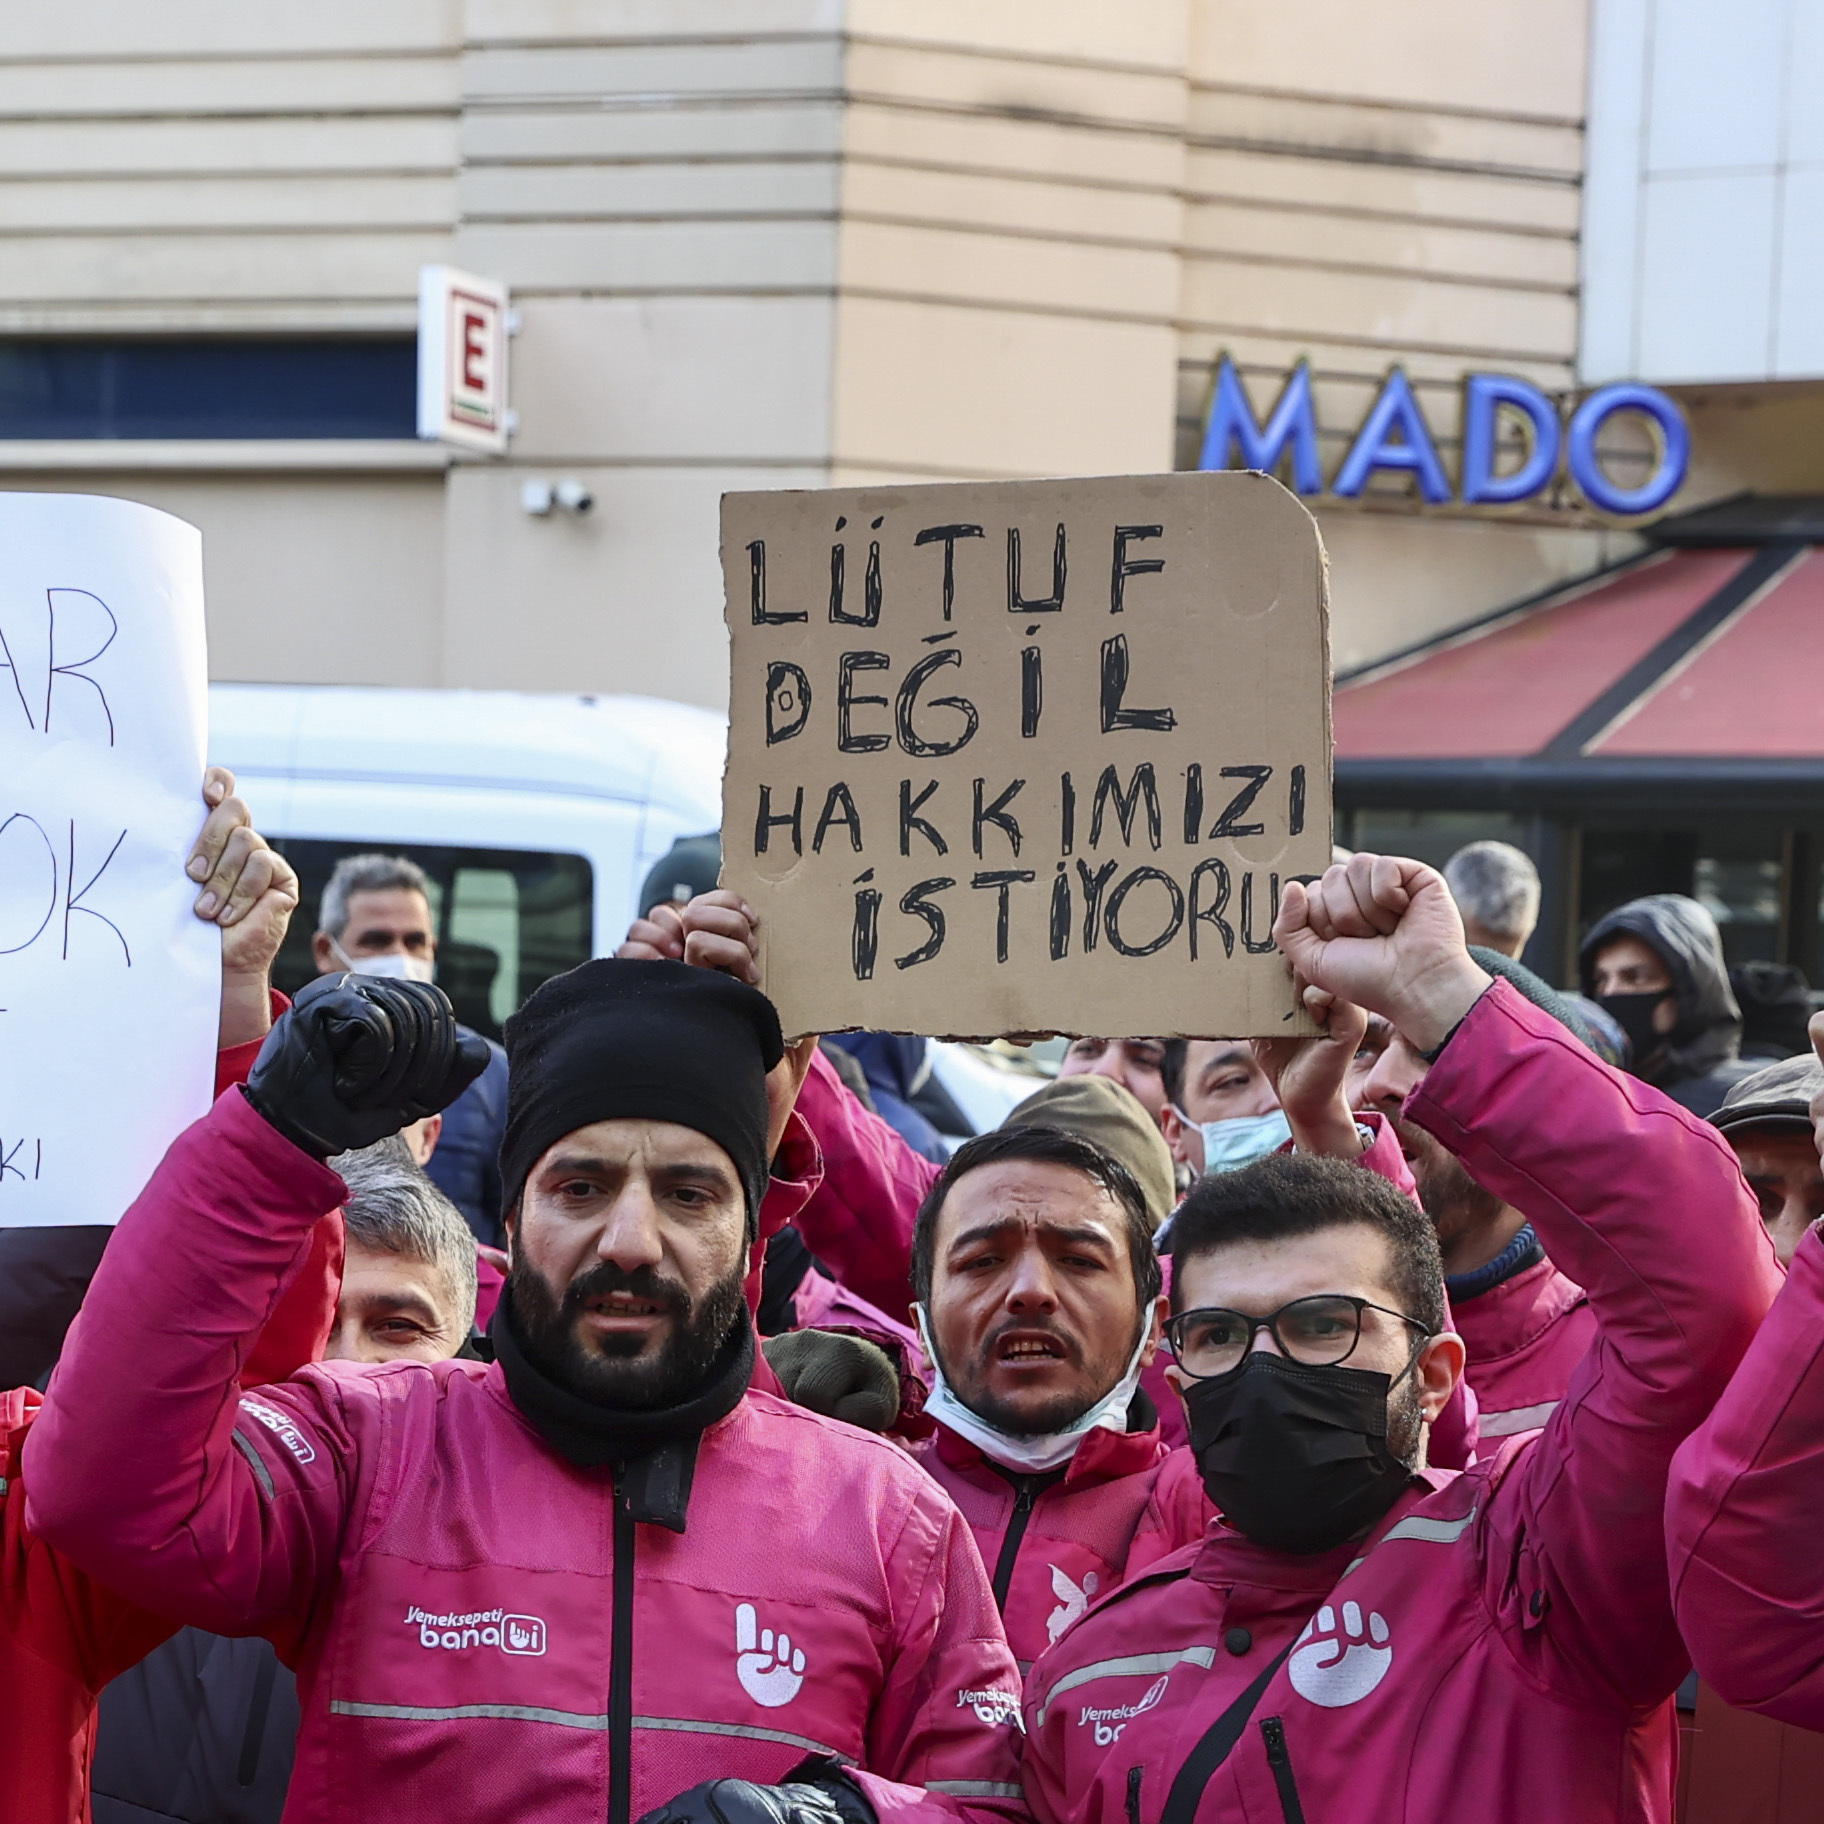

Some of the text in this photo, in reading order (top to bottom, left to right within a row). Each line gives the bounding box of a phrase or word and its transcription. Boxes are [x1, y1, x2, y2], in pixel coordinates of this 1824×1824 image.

[462, 313, 485, 391] E
[1197, 348, 1692, 517] MADO
[746, 515, 1166, 627] LÜTUF
[766, 624, 1177, 757] DEĞİL
[754, 762, 1306, 856] HAKKIMIZI
[852, 858, 1322, 980] İSTİYORU
